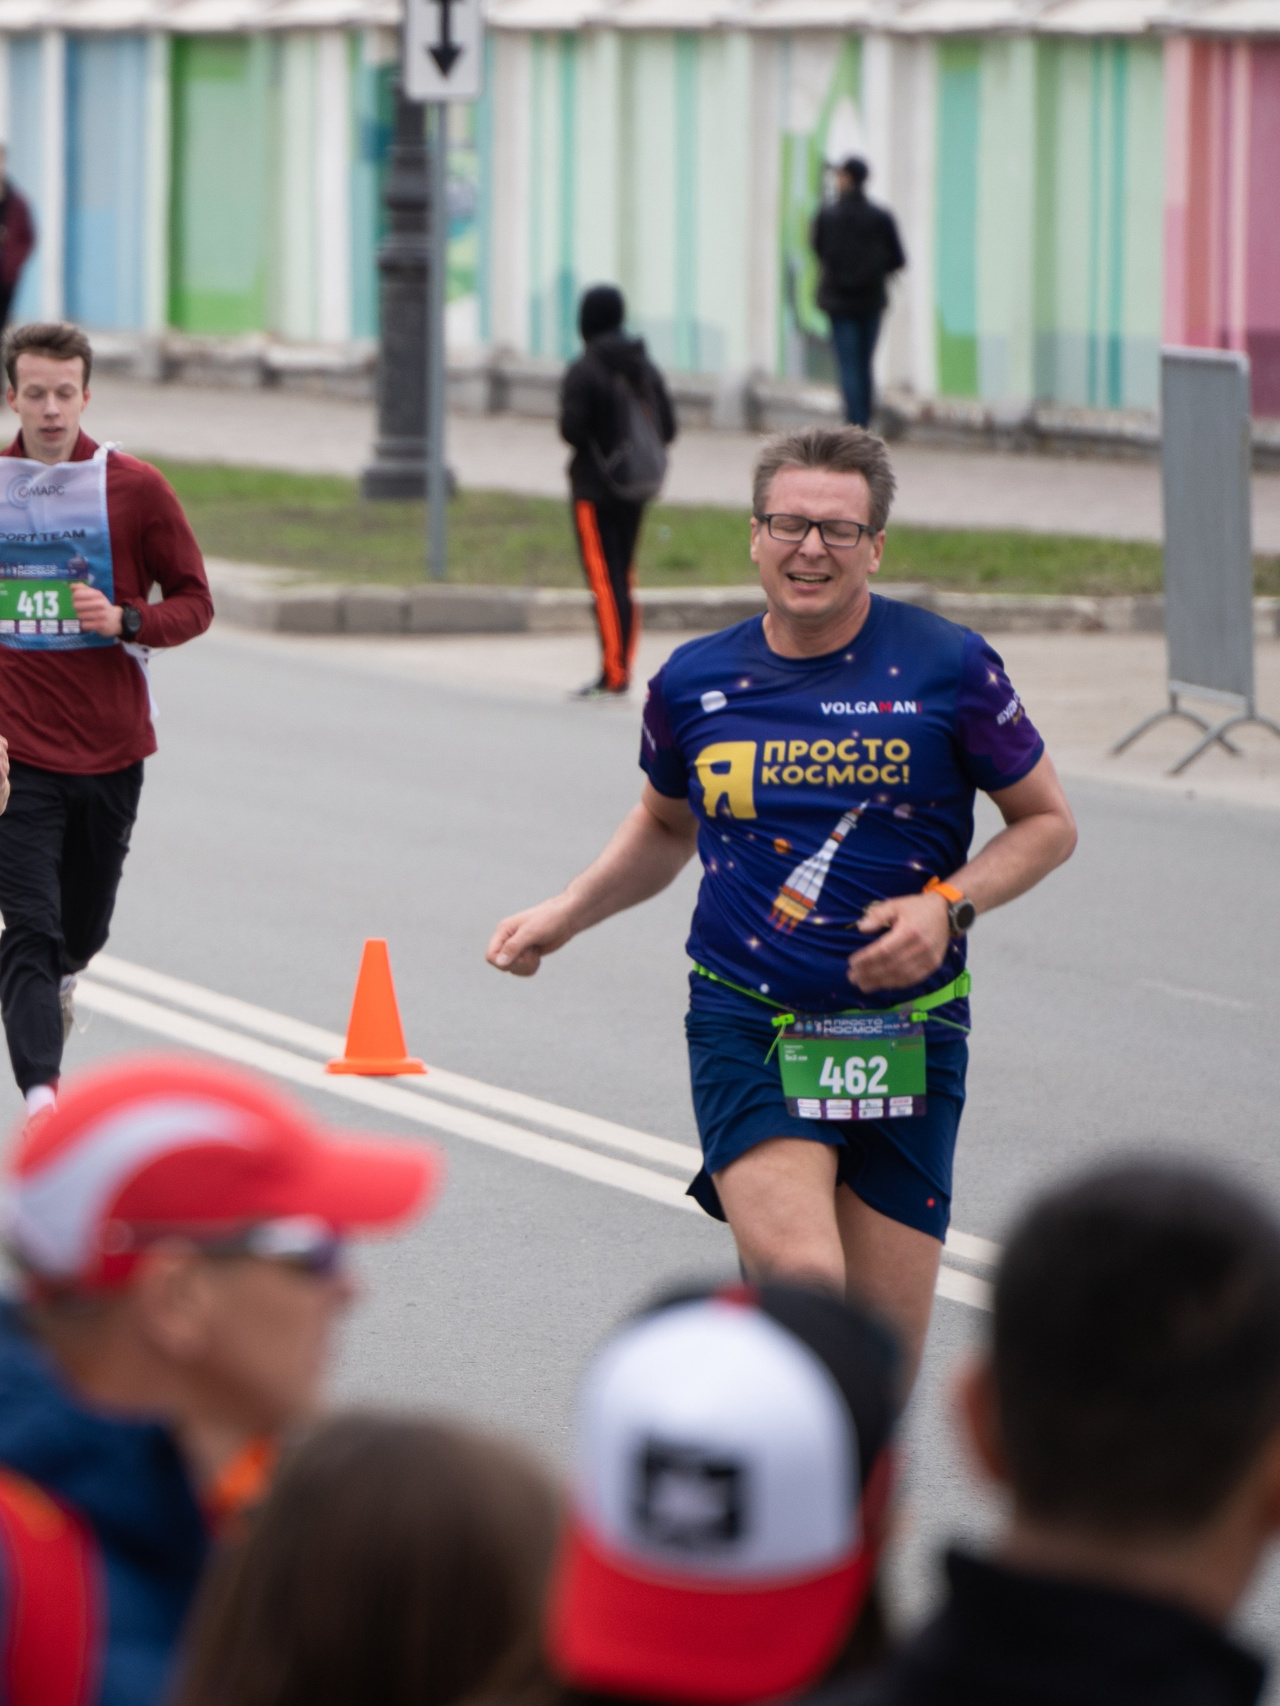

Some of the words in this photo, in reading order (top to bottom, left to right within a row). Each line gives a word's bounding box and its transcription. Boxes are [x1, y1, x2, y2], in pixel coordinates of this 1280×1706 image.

[40, 528, 86, 542] TEAM
[17, 590, 60, 617] 413
[820, 700, 917, 715] VOLGAMAN
[695, 740, 758, 819] Я
[763, 739, 911, 763] ПРОСТО
[761, 764, 910, 785] КОСМОС!
[824, 1025, 883, 1034] КОСМОС
[834, 1018, 883, 1026] ПРОСТО
[819, 1055, 889, 1095] 462
